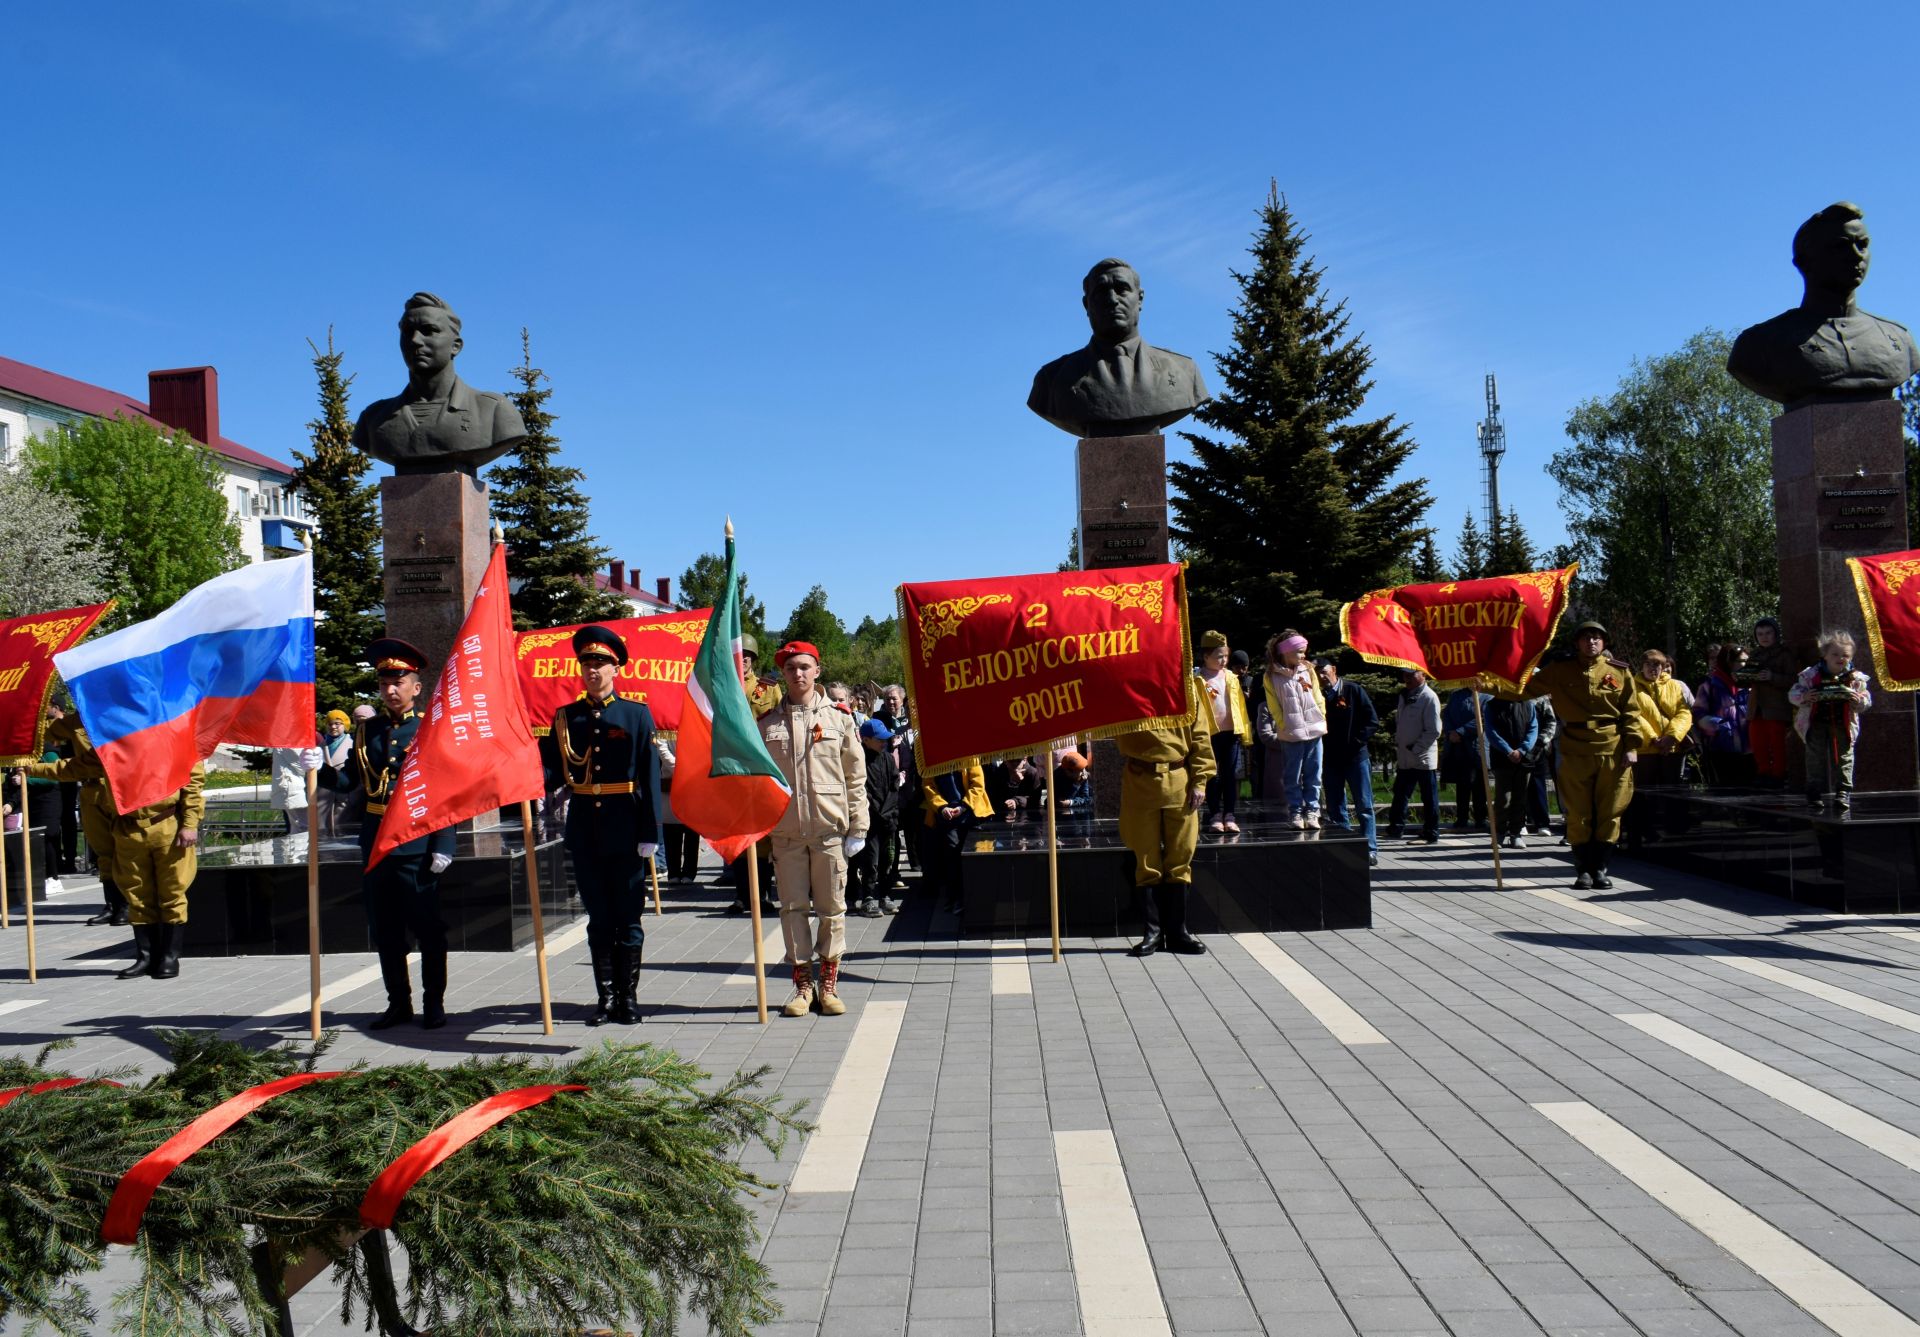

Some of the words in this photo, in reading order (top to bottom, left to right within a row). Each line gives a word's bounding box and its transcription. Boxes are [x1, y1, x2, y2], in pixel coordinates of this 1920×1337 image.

[1841, 506, 1887, 516] ШАРИПОВ
[1107, 538, 1145, 548] ЕВСЕЕВ
[1439, 583, 1458, 594] 4
[1026, 603, 1048, 628] 2
[462, 634, 482, 655] 150
[942, 623, 1140, 693] БЕЛОРУССКИЙ
[1009, 679, 1085, 727] ФРОНТ
